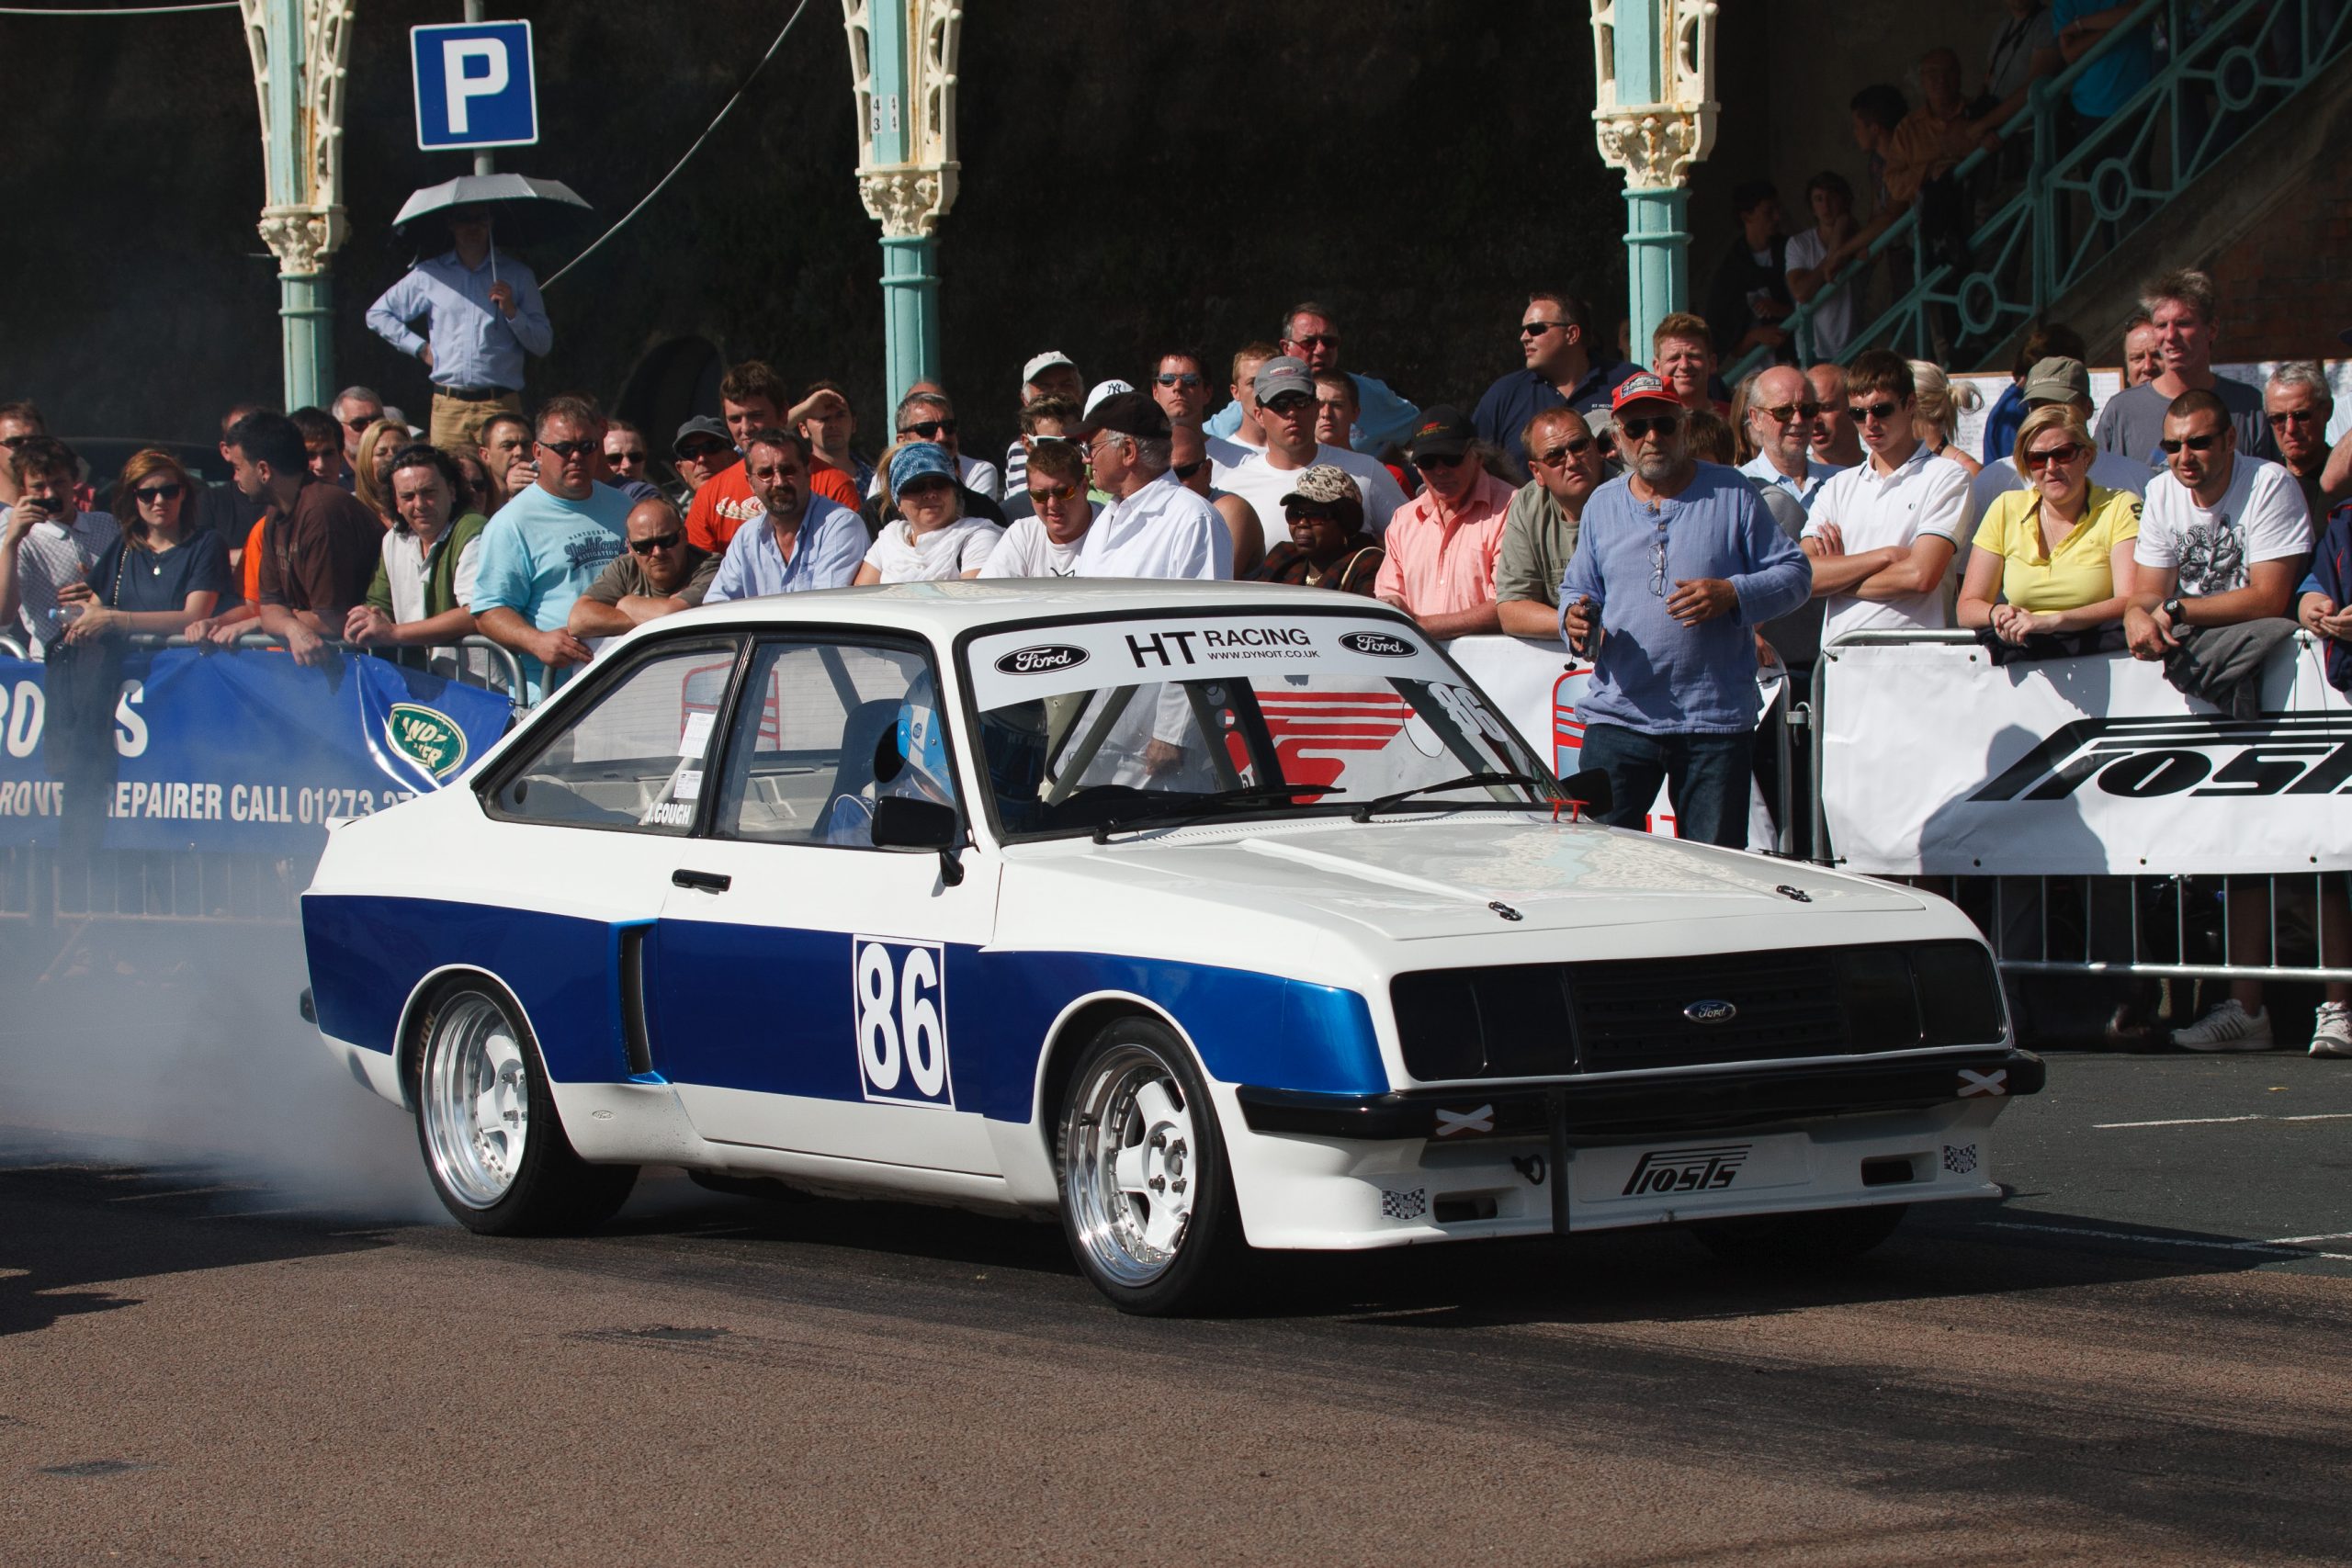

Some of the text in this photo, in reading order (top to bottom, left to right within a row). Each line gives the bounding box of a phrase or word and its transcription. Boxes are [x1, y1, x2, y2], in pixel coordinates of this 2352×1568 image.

[442, 38, 510, 133] P
[1015, 649, 1072, 671] Ford
[1125, 628, 1311, 669] HT RACING
[1206, 649, 1321, 660] WWW.DYNOIT.CO.UK
[1356, 635, 1404, 653] Ford
[1427, 682, 1509, 742] 86
[0, 781, 64, 817] ROVE
[231, 784, 293, 822] CALL
[299, 787, 375, 825] 01273
[858, 942, 944, 1097] 86
[1698, 1003, 1726, 1018] Ford
